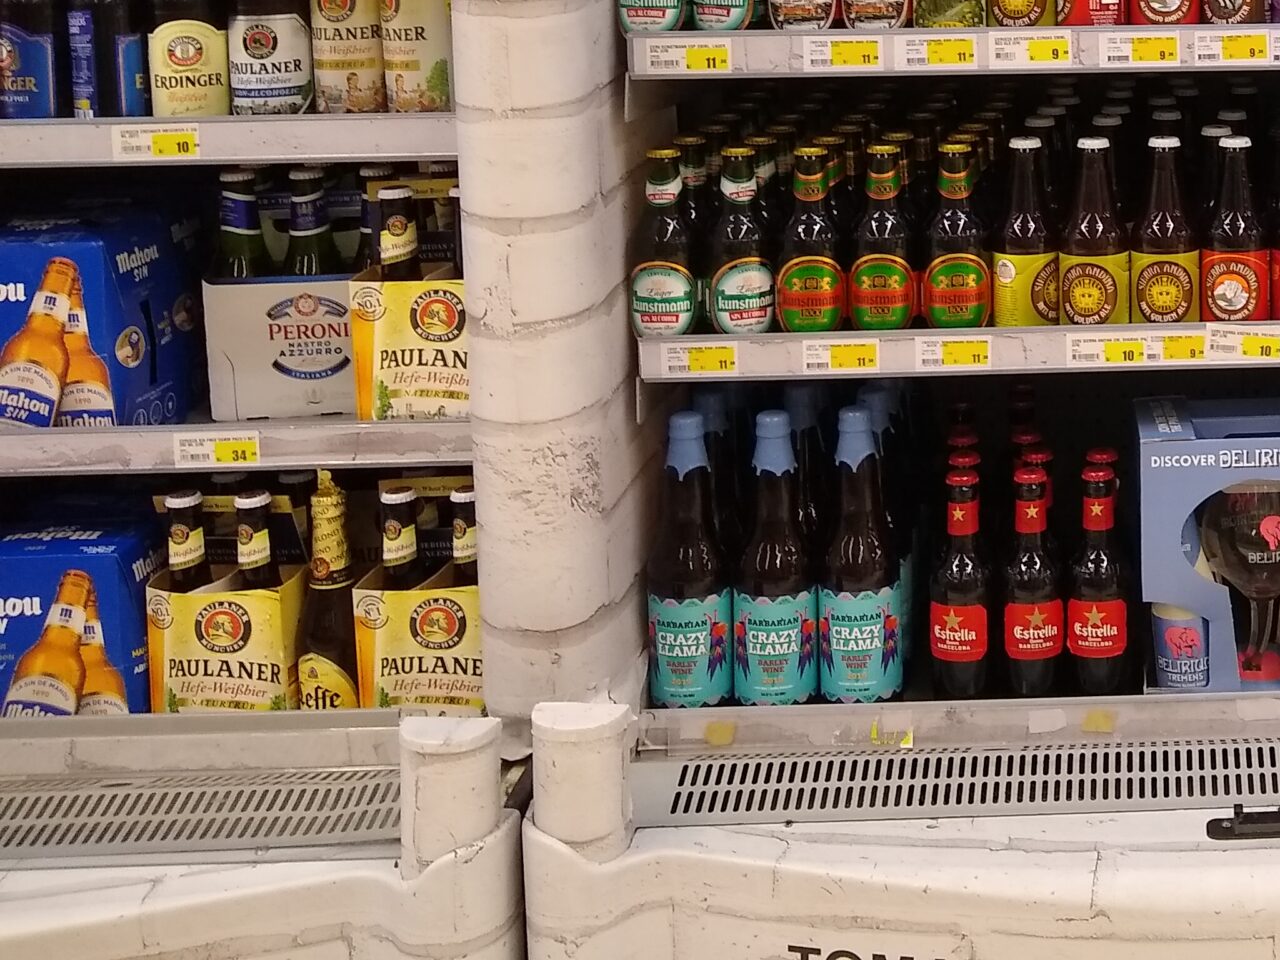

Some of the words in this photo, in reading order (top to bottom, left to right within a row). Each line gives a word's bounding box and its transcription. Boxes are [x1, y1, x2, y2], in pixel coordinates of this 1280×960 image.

[705, 57, 716, 68] 11
[862, 54, 871, 64] 11
[957, 52, 967, 62] 11
[231, 60, 302, 74] PAULANER
[155, 73, 223, 89] ERDINGER
[177, 142, 189, 152] 10
[116, 245, 159, 274] Mahou
[133, 267, 150, 282] SIN
[1063, 265, 1082, 291] SIERRA
[1086, 265, 1115, 292] ANDINA
[1138, 263, 1160, 290] SIERRA
[1163, 263, 1191, 291] ANDINA
[632, 298, 691, 312] kunstmann
[269, 322, 350, 341] PERONI
[279, 347, 342, 357] AZZURRO
[1122, 350, 1134, 361] 10
[1260, 345, 1271, 356] 10
[718, 360, 728, 369] 11
[857, 357, 866, 366] 11
[972, 354, 981, 363] 11
[232, 450, 246, 461] 34
[1151, 454, 1215, 468] DISCOVER
[750, 628, 798, 643] CRAZY
[832, 624, 880, 639] CRAZY
[934, 625, 977, 641] Estrella
[1014, 624, 1057, 640] Estrella
[1074, 622, 1118, 637] Estrella
[658, 630, 706, 645] CRAZY
[832, 637, 881, 652] LLAMA
[658, 642, 706, 658] LLAMA
[750, 640, 798, 656] LLAMA
[666, 660, 698, 668] BARLEY
[757, 658, 790, 666] BARLEY
[840, 653, 873, 662] BARLEY
[169, 657, 281, 684] PAULANER
[381, 656, 483, 677] PAULANE
[670, 667, 693, 675] WINE
[761, 664, 785, 673] WINE
[846, 660, 868, 670] WINE
[1167, 672, 1204, 682] TREMENS
